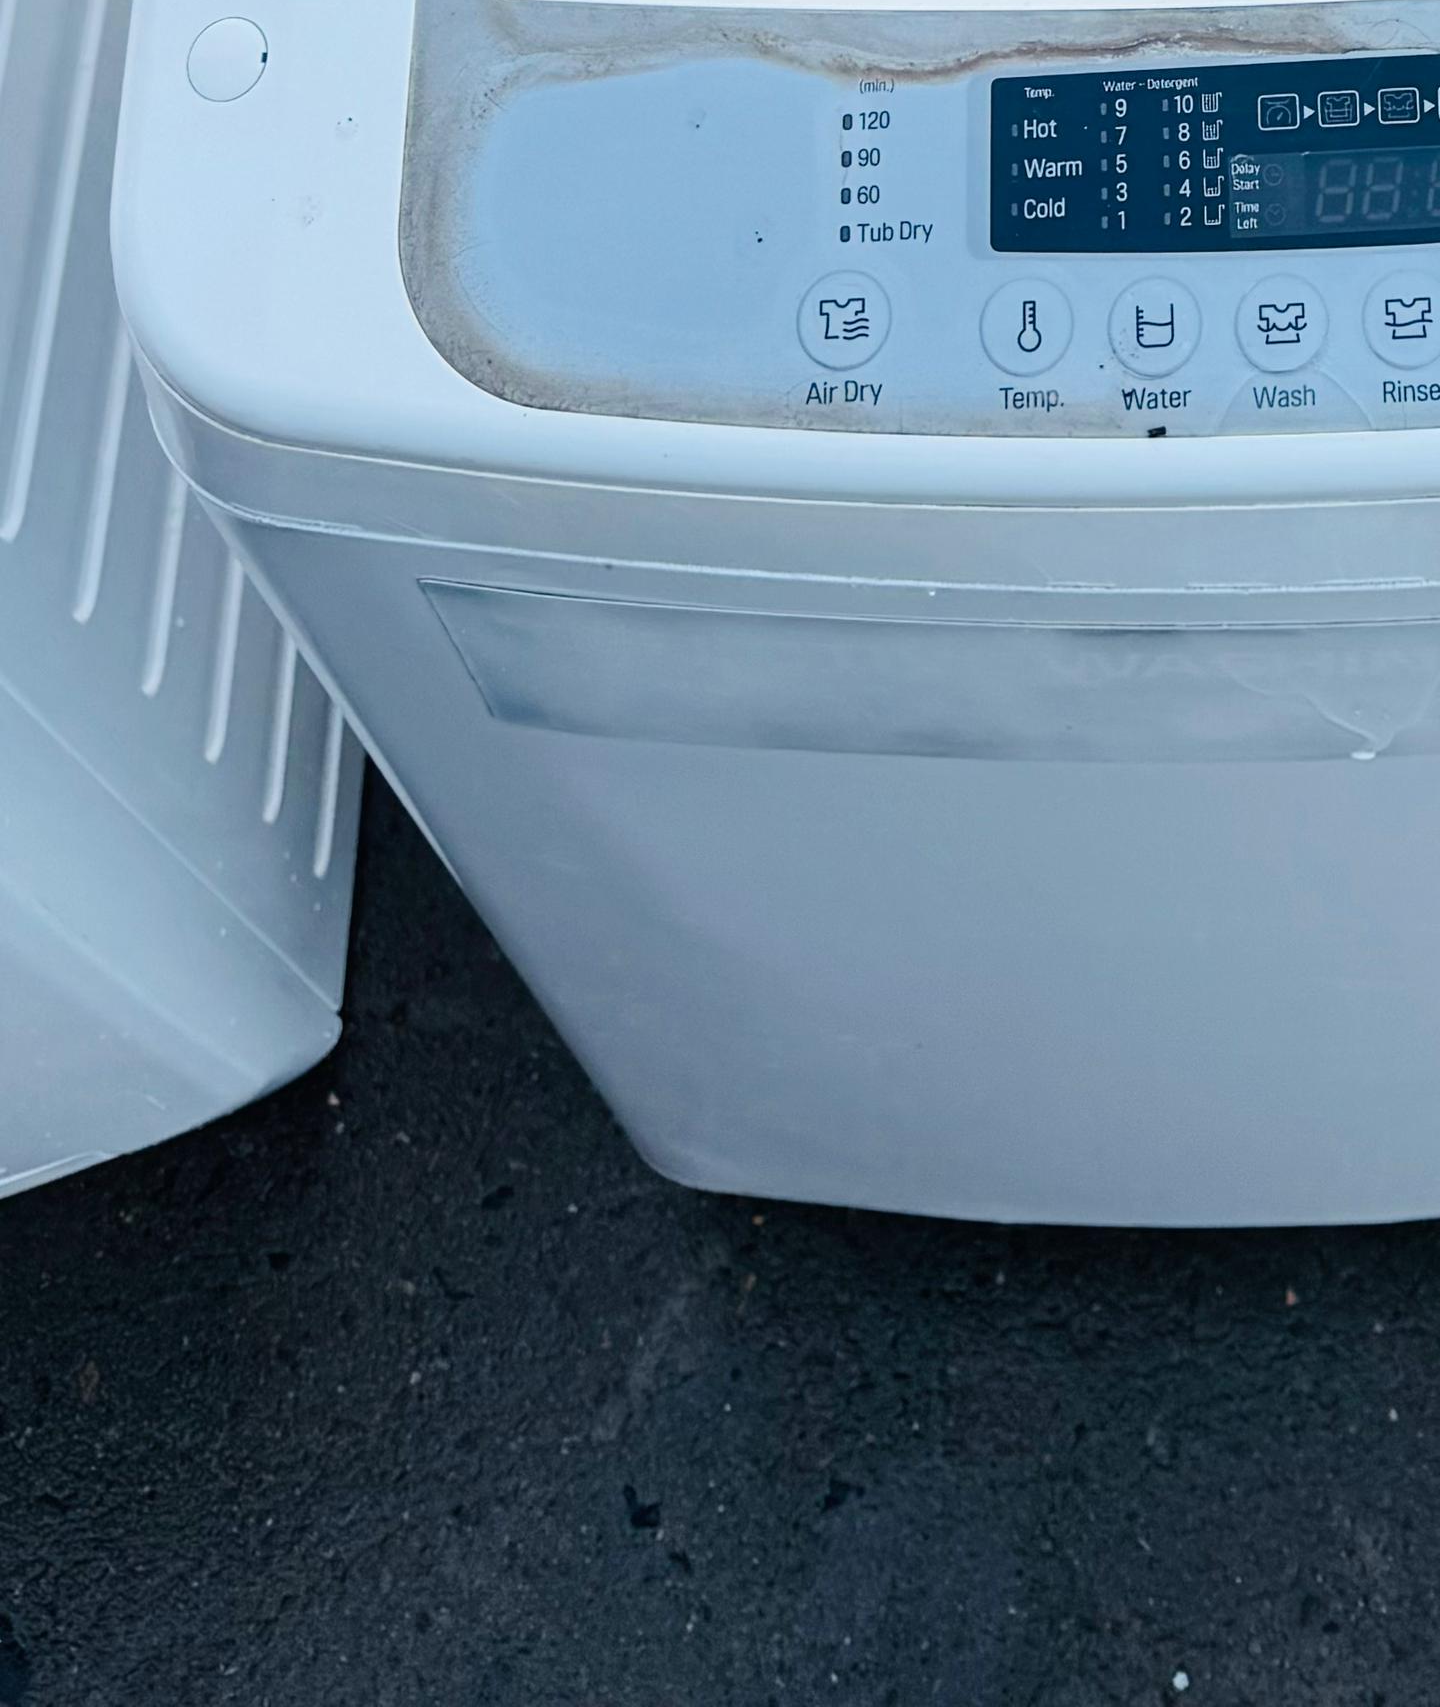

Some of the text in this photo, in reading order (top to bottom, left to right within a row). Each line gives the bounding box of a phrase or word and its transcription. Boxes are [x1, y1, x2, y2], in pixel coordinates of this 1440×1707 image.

[1103, 81, 1136, 93] Water
[1147, 77, 1199, 90] Detergent
[1114, 98, 1128, 118] 9
[1174, 94, 1194, 114] 10
[859, 110, 890, 130] 120
[1023, 119, 1057, 139] Hot
[1114, 125, 1127, 145] 7
[1177, 122, 1191, 142] 8
[857, 148, 881, 166] 90
[1115, 153, 1128, 174] 5
[1178, 150, 1191, 170] 6
[1024, 158, 1083, 178] Warm
[857, 185, 880, 204] 60
[1116, 182, 1128, 202] 3
[1178, 178, 1192, 198] 4
[1024, 197, 1066, 219] Cold
[1179, 206, 1192, 227] 2
[1117, 210, 1127, 230] 1
[857, 221, 933, 243] Tub Dry
[805, 380, 883, 406] Air Dry
[999, 386, 1065, 412] Temp.
[1121, 387, 1192, 411] Water
[1252, 384, 1317, 410] Wash
